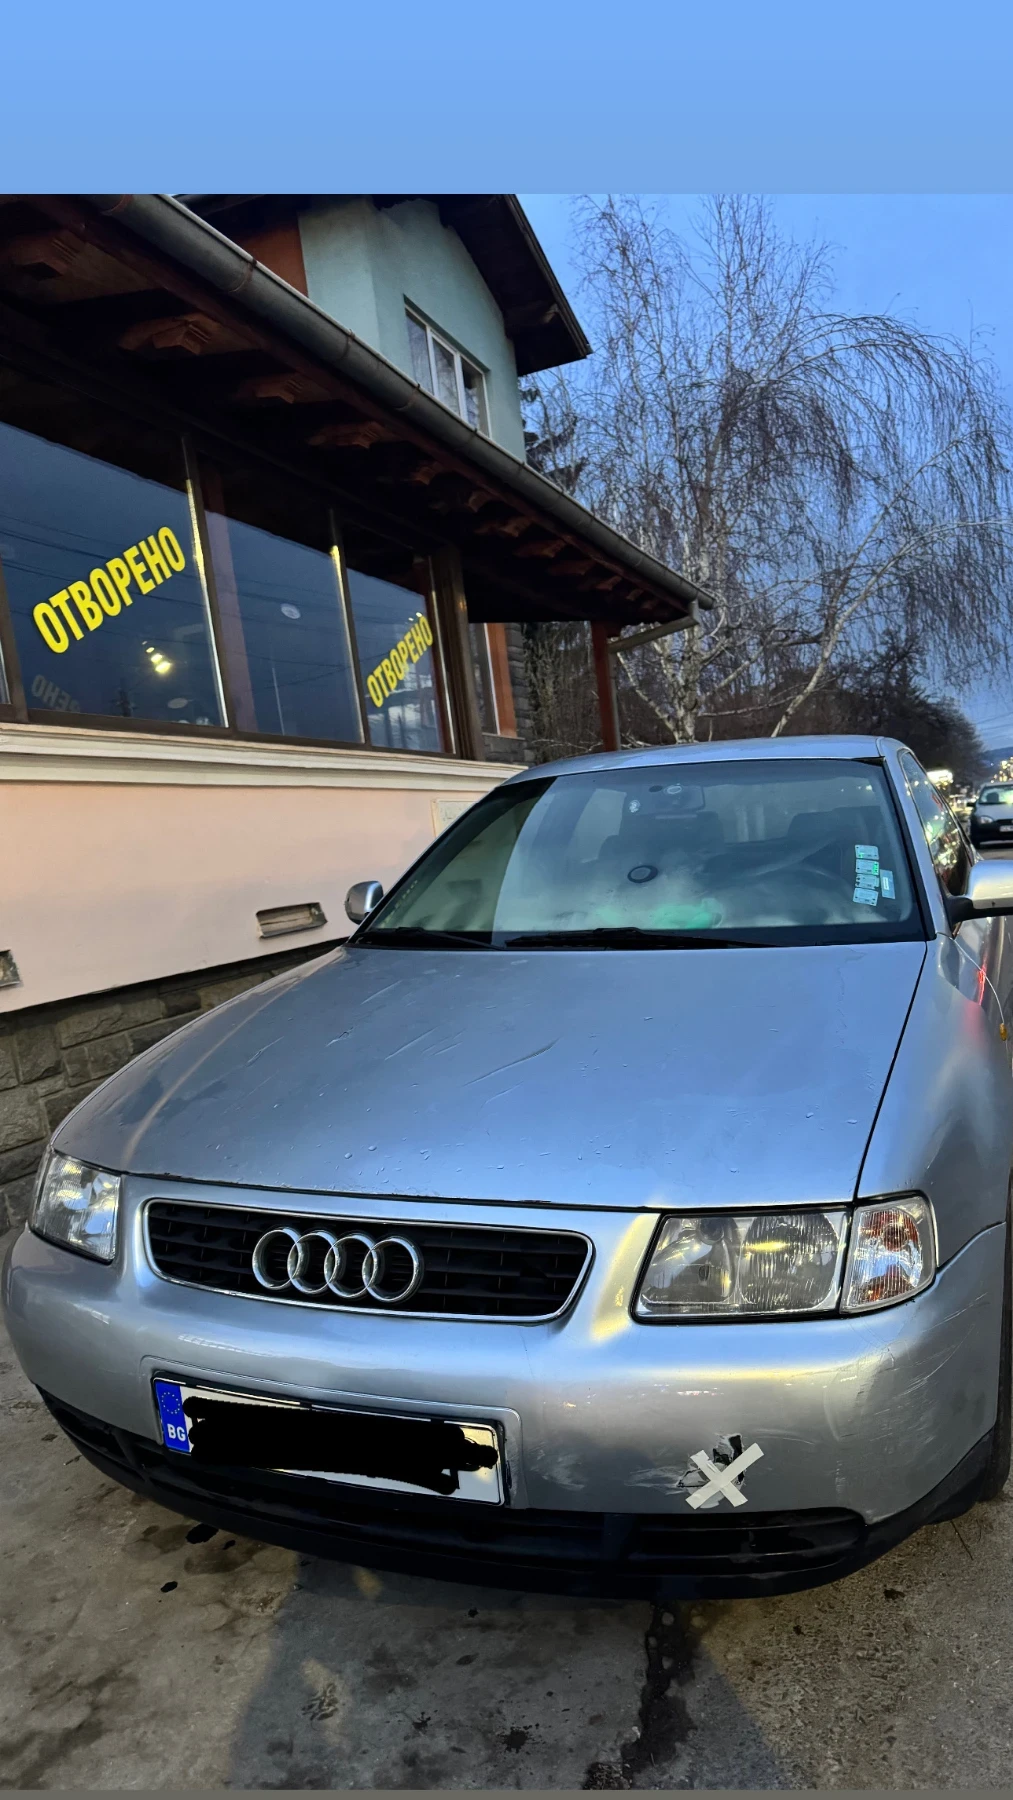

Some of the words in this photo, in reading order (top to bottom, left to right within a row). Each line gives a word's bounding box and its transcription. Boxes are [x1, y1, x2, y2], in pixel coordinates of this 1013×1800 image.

[33, 527, 185, 653] ОТВОРЕНО
[367, 615, 434, 708] ОТВОРЕНО
[167, 1424, 186, 1441] BG
